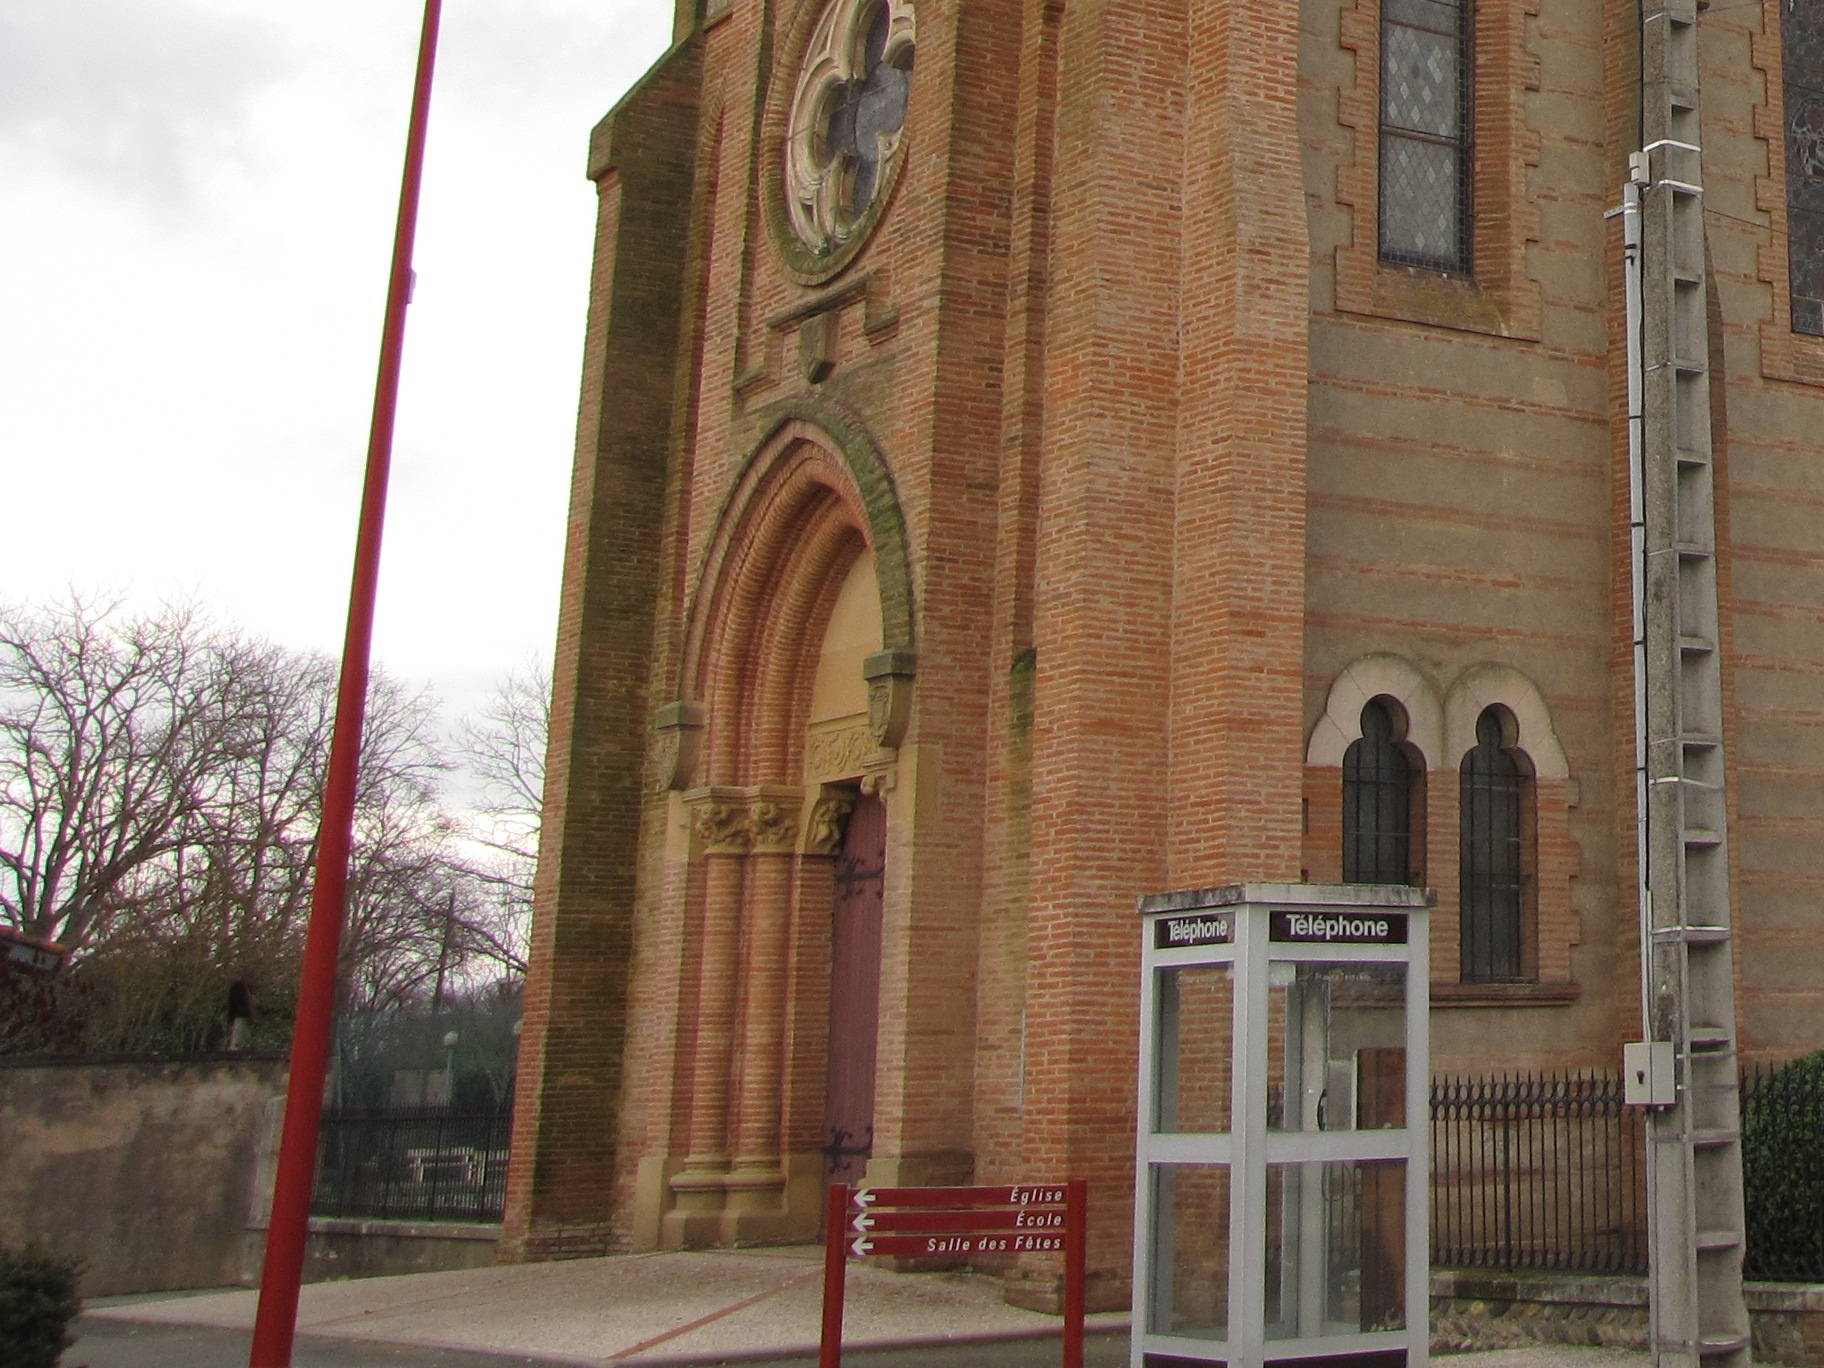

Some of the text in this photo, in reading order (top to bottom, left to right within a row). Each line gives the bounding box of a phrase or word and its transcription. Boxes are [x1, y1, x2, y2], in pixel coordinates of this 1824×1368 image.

[1168, 918, 1228, 943] Téléphone
[1286, 913, 1389, 940] Téléphone
[1010, 1186, 1062, 1205] Église
[1016, 1210, 1062, 1227] École
[927, 1235, 1062, 1252] Salle des Fêtes
